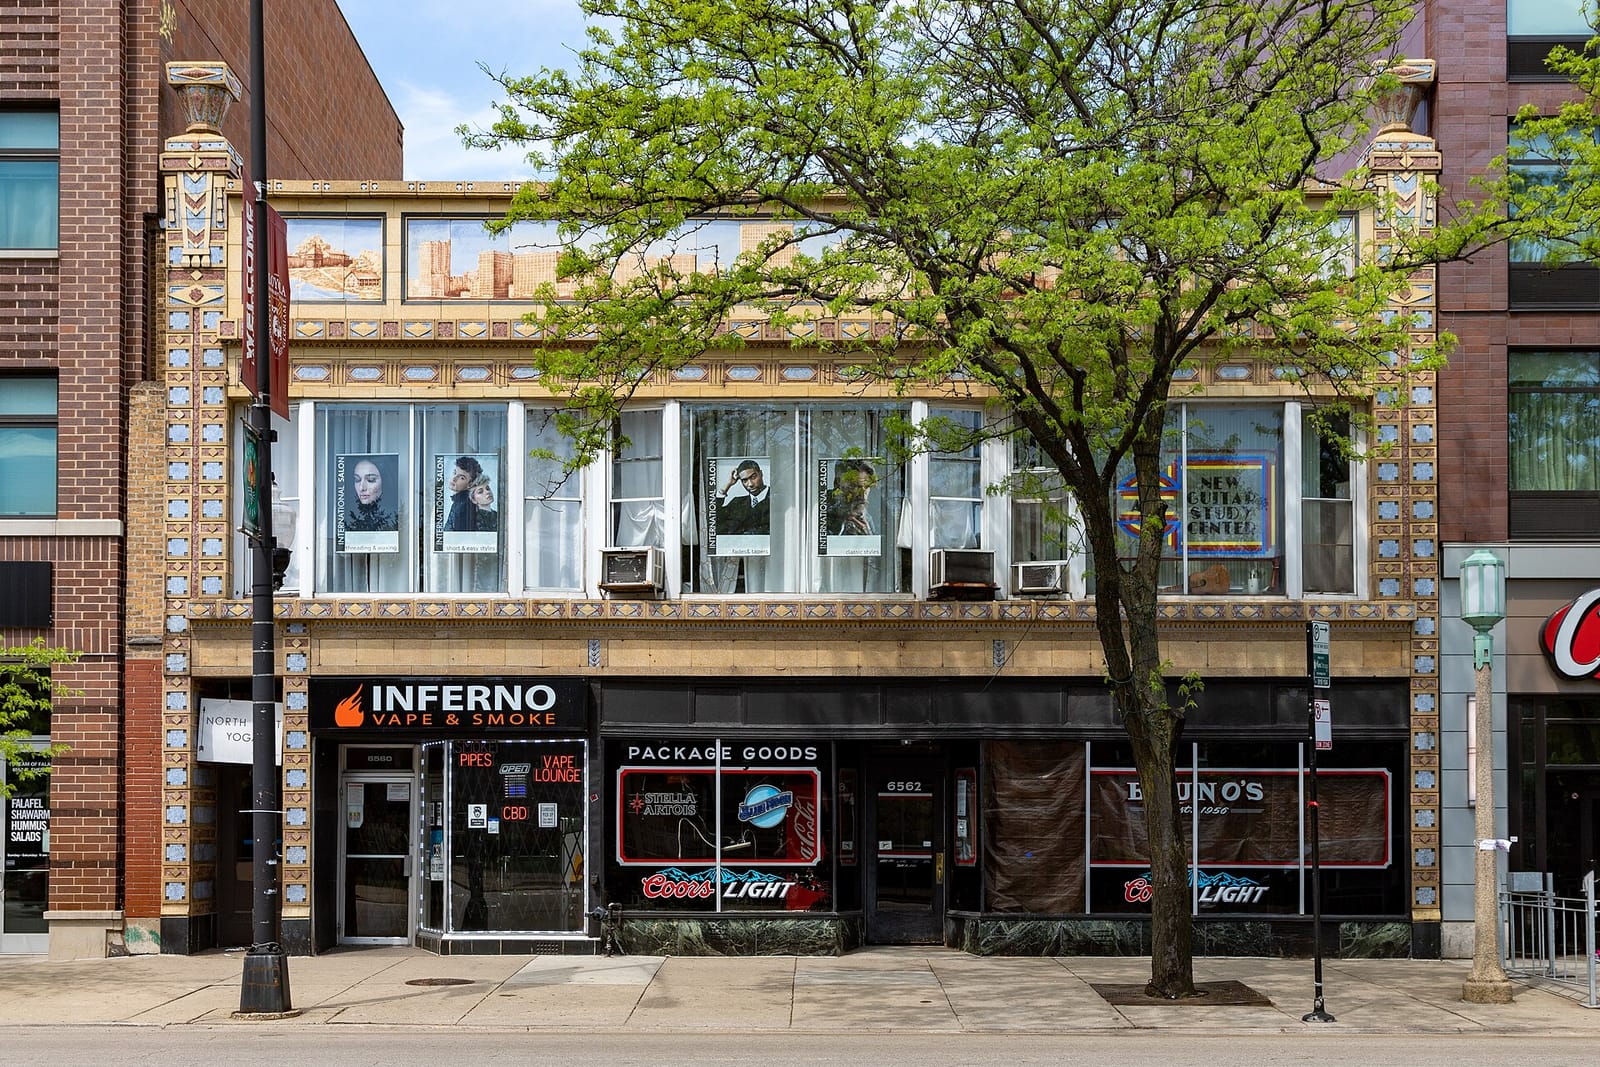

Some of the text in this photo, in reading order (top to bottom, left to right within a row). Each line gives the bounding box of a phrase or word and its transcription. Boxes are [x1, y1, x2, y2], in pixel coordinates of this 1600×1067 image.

[246, 200, 255, 359] WELCOME
[1201, 477, 1239, 490] NEW
[708, 461, 716, 549] INTERNATIONAL SALON
[819, 461, 827, 549] INTERNATIONAL SALON
[1190, 506, 1251, 520] STUDY
[1187, 521, 1256, 535] CENTER
[372, 685, 556, 711] INFERNO
[207, 717, 247, 726] NORTH
[372, 713, 556, 726] VAPE & SMOKE
[226, 732, 254, 742] YOG
[628, 746, 818, 760] PACKAGE GOODS
[460, 753, 492, 767] PIPES
[543, 755, 575, 769] VAPE
[534, 769, 581, 782] LOUNGE
[887, 782, 922, 792] 6562
[1127, 780, 1264, 803] BUNO'S
[12, 799, 43, 808] FALAFEL
[644, 793, 696, 804] STELLA
[11, 810, 50, 819] SHAWARM
[643, 805, 697, 816] ARTOIS
[11, 821, 47, 831] HUMMUS
[11, 832, 41, 841] SALADS
[642, 874, 796, 899] Coors LIGHT
[1199, 886, 1270, 904] LIGHT
